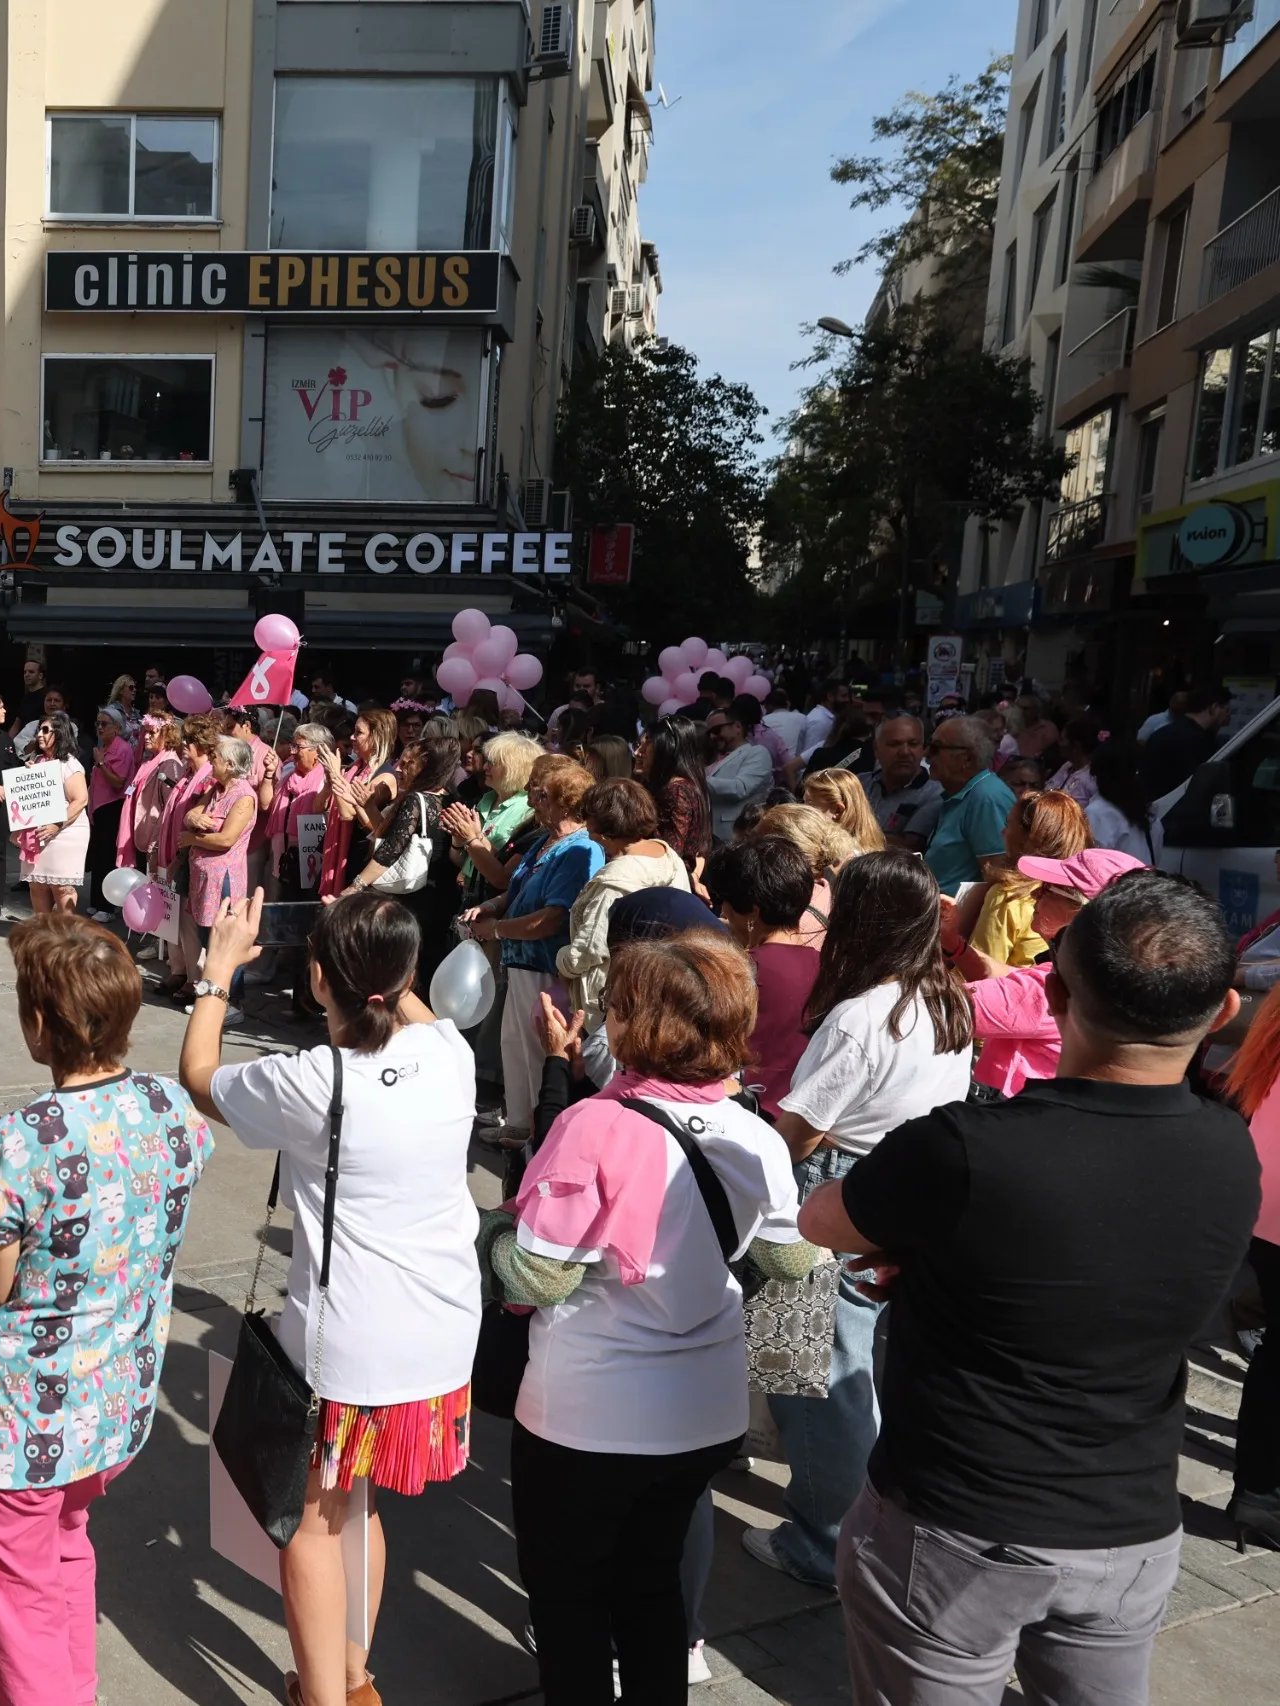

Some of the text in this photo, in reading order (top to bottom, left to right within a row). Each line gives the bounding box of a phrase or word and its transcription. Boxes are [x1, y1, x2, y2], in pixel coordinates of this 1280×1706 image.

[74, 254, 470, 308] clinic EPHESUS
[291, 379, 316, 389] İZMİR
[1186, 527, 1227, 542] mion
[53, 525, 348, 574] SOULMATE
[364, 532, 573, 574] COFFEE
[10, 782, 45, 794] KONTROL
[19, 790, 51, 802] HAYATINI
[22, 800, 50, 811] KURTAR
